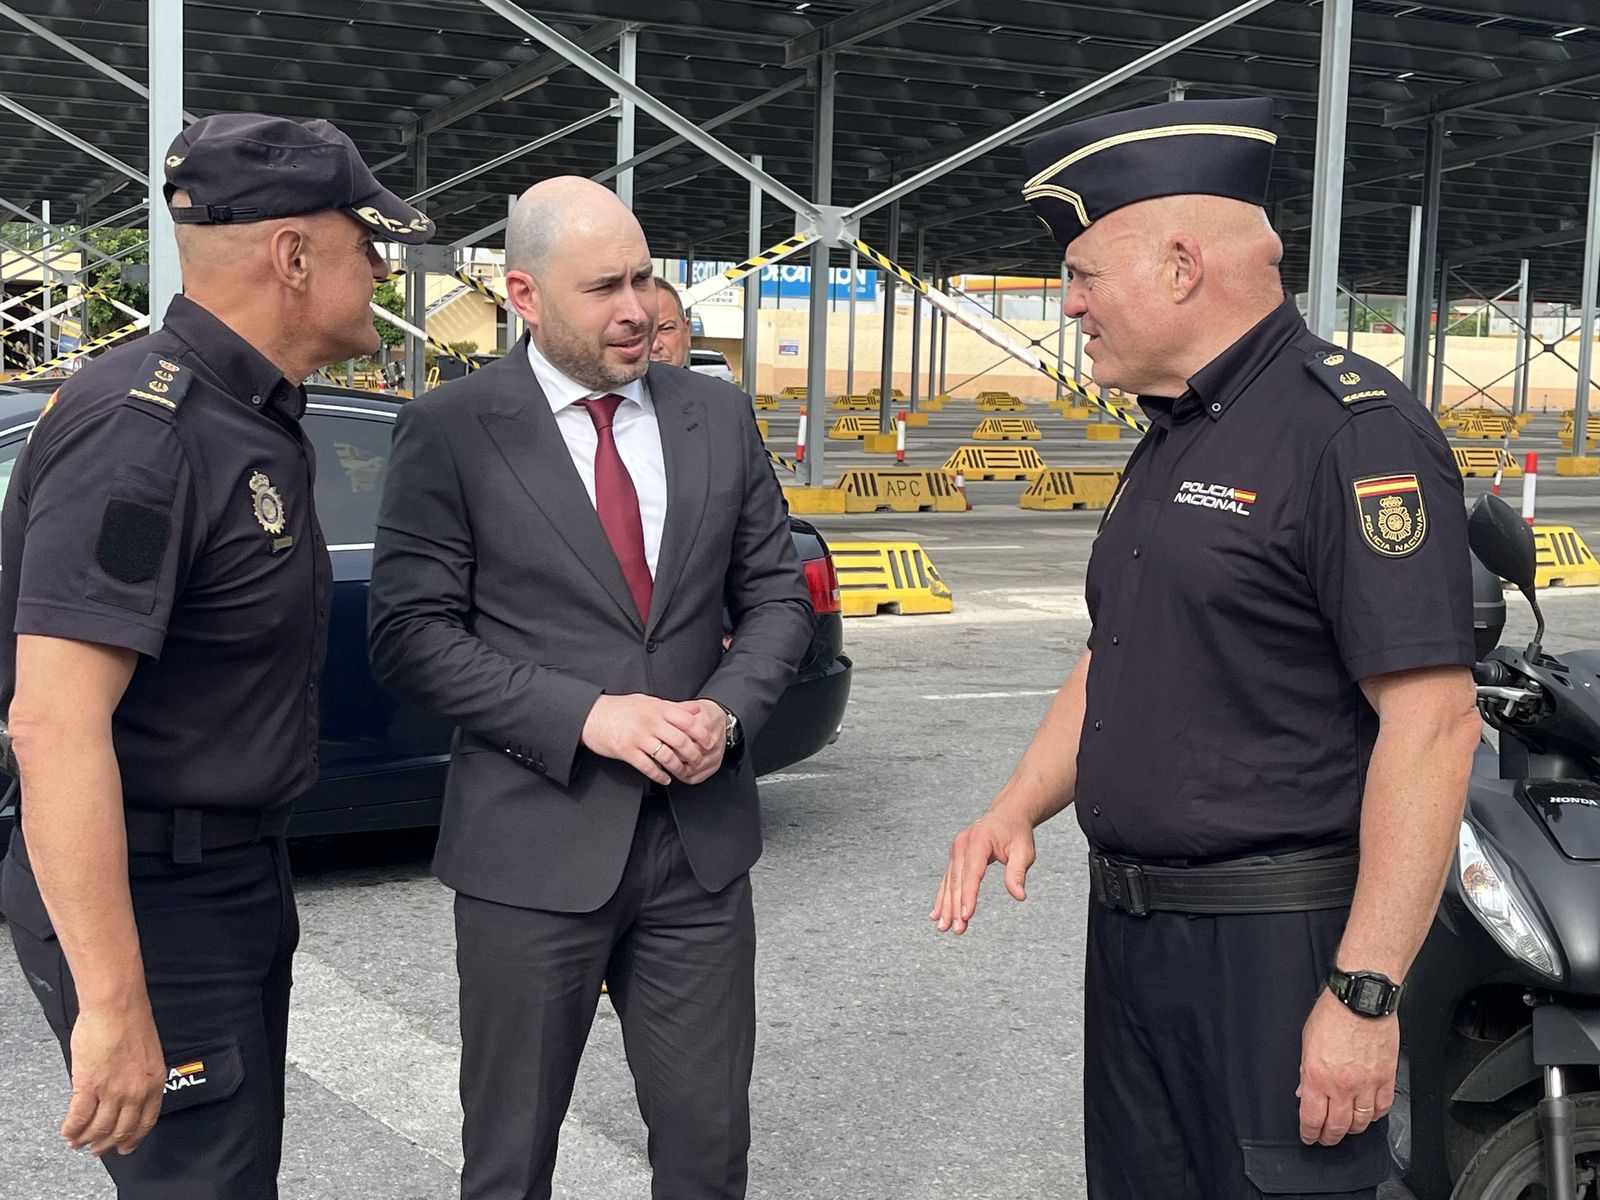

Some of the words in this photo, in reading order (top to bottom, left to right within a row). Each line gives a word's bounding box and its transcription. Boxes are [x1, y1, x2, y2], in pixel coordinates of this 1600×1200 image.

[887, 480, 920, 497] APC
[1180, 481, 1235, 499] POLICIA
[1174, 492, 1250, 516] NACIONAL
[1364, 514, 1391, 551] POLICIA
[1395, 508, 1424, 551] NACIONAL
[1550, 797, 1598, 806] HONDA
